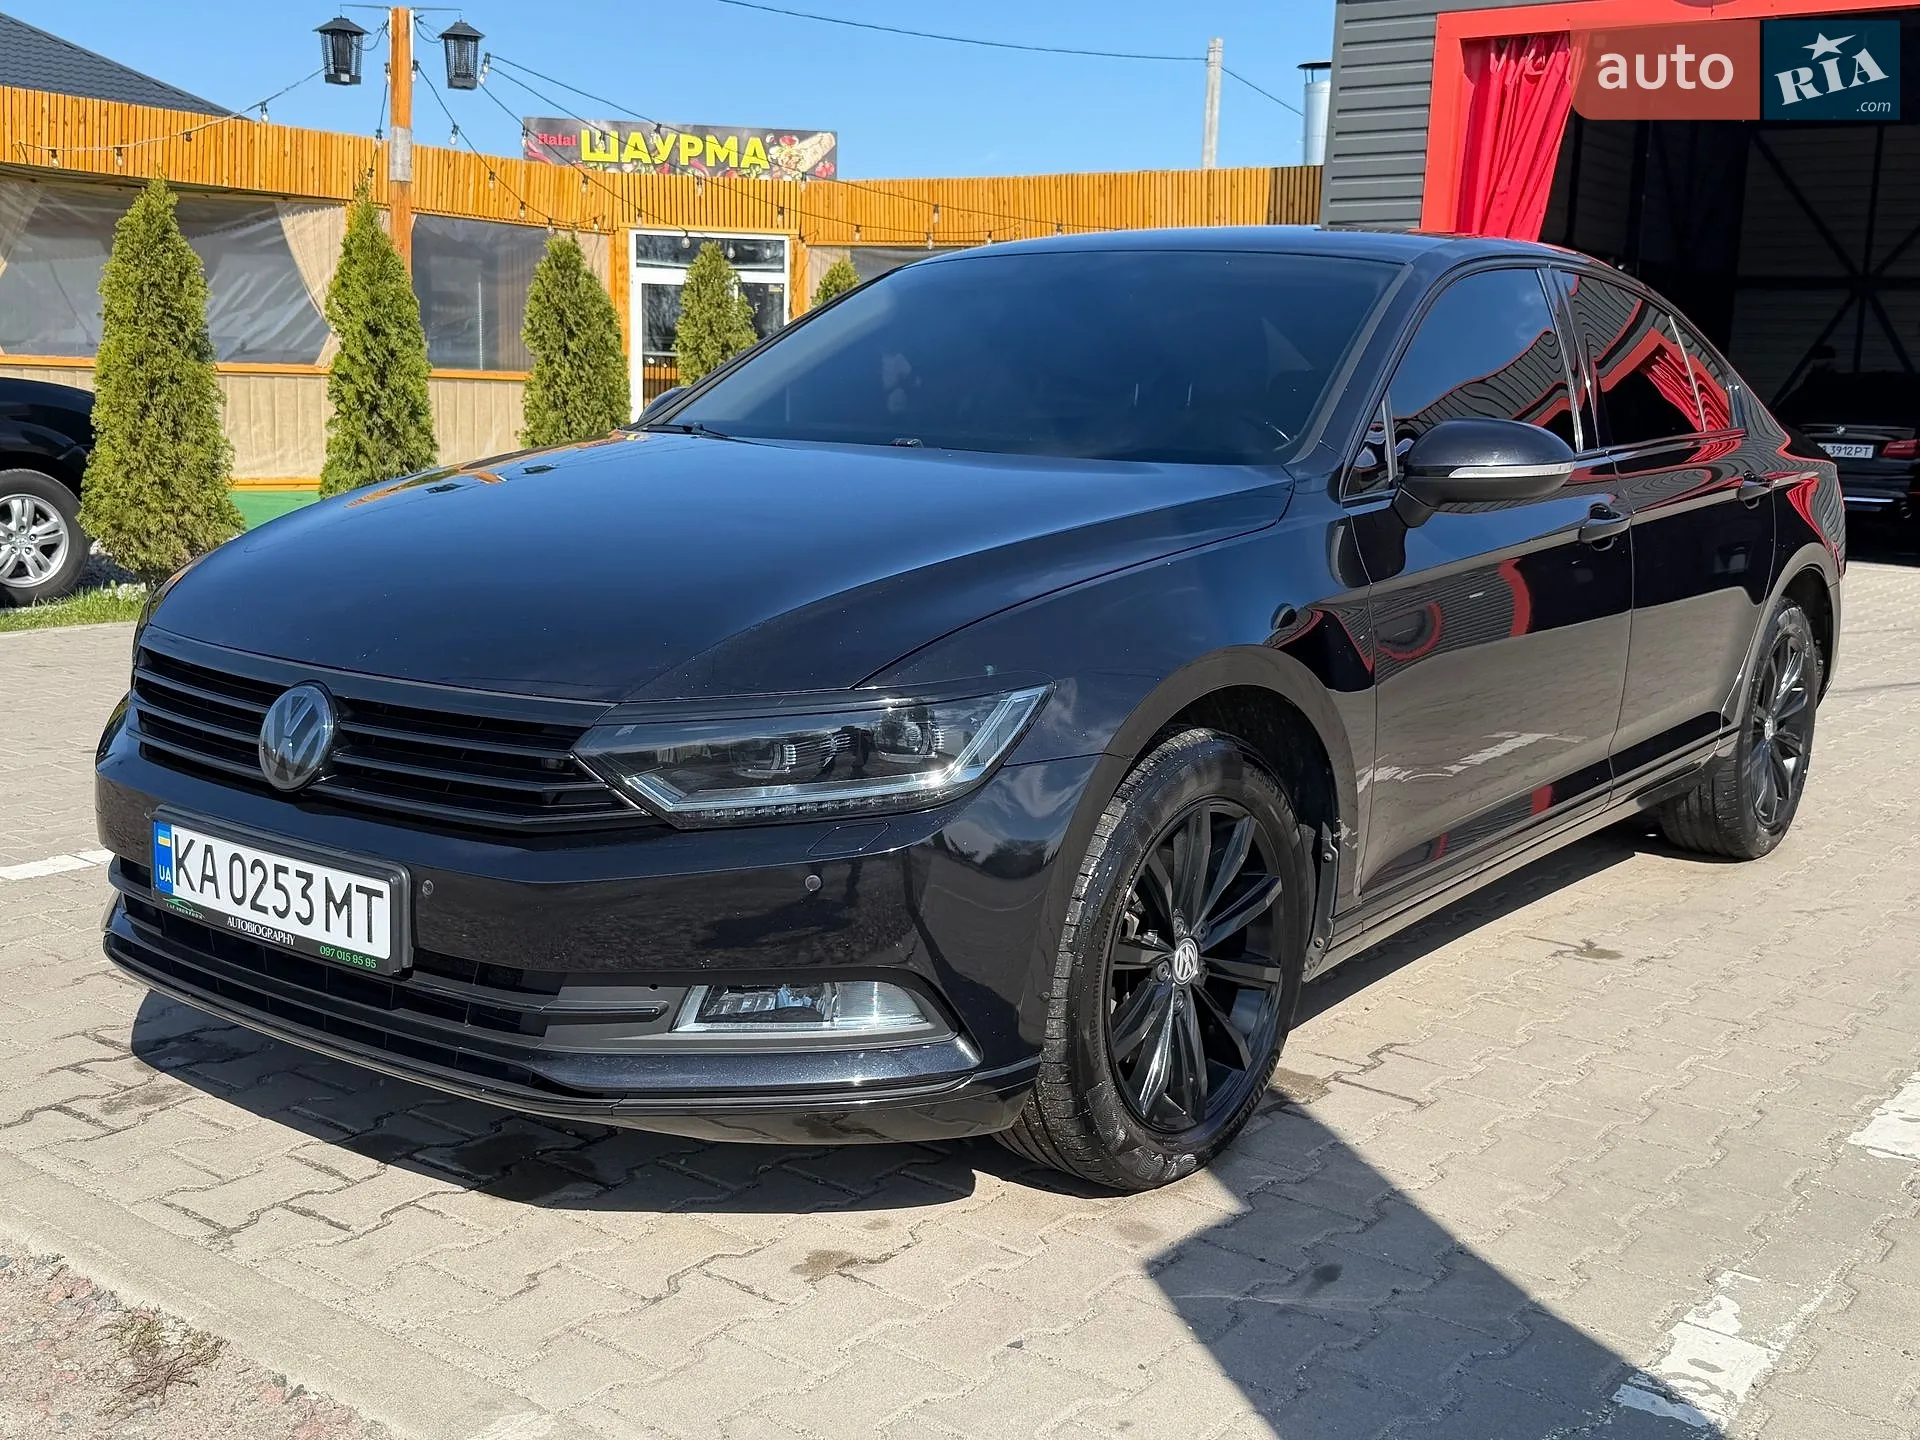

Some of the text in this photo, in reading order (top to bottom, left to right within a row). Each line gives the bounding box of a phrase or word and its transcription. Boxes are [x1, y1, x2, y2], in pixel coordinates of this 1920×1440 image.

[537, 133, 577, 146] Halal
[580, 129, 771, 169] ШАУРМА
[1831, 445, 1853, 456] 3912
[159, 864, 172, 883] UA
[174, 834, 384, 944] KA 0253 MT
[226, 916, 296, 946] AUTOBIOGRAPHY
[320, 945, 377, 969] 097 015 95 95
